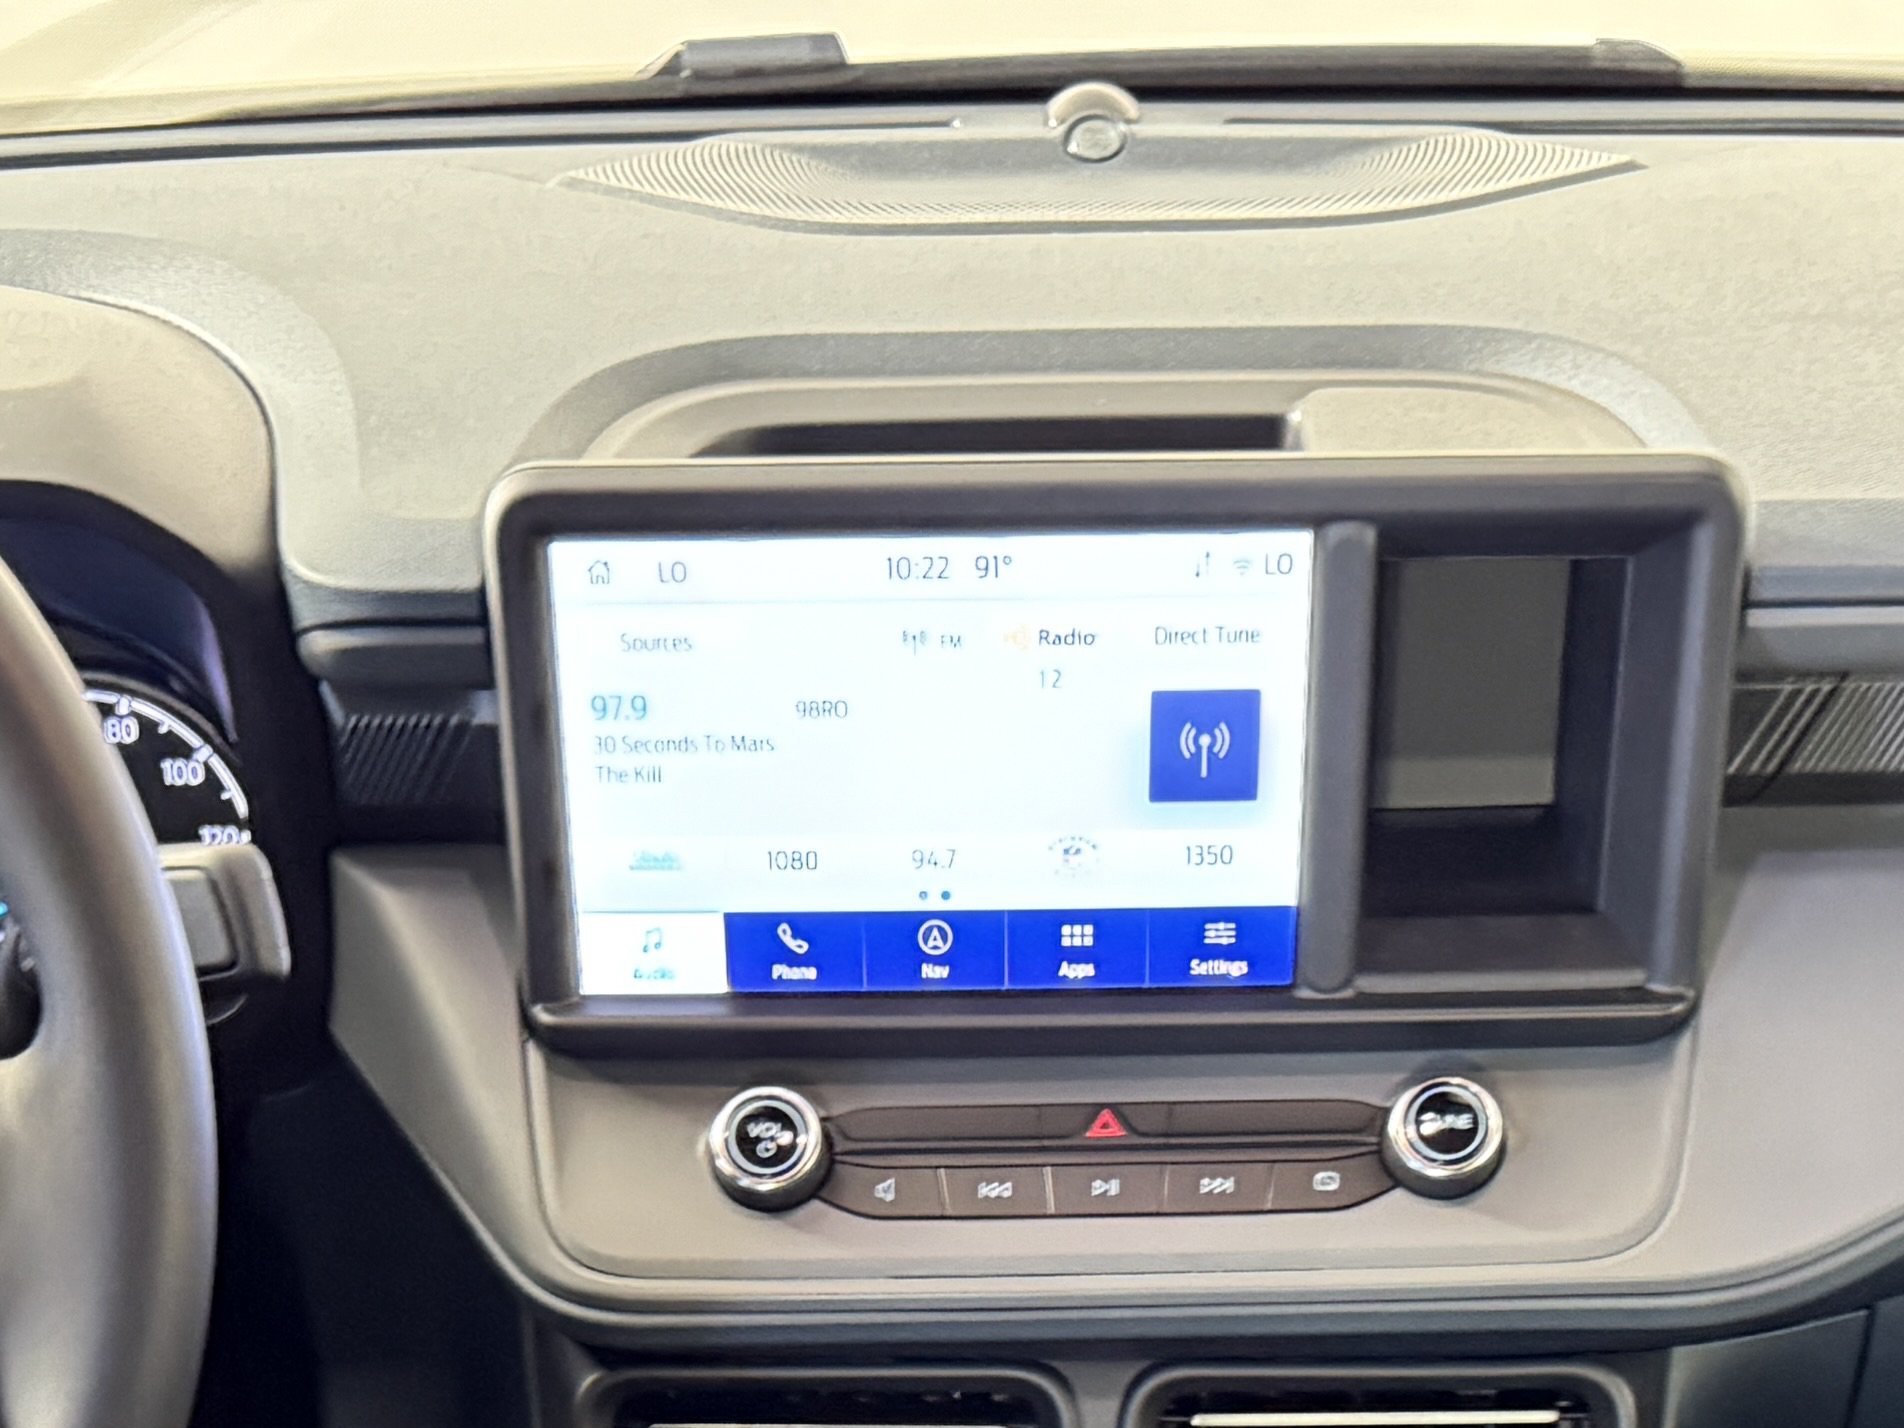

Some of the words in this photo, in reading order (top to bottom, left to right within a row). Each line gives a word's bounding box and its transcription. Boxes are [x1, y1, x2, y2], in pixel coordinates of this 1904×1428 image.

[887, 556, 950, 581] 10:22
[620, 633, 693, 652] Sources
[1038, 628, 1096, 647] Radio
[1155, 626, 1207, 646] Direct
[1215, 625, 1261, 645] Tune
[591, 695, 647, 721] 97.9
[104, 716, 140, 745] 80
[594, 735, 616, 754] 30
[622, 735, 698, 754] Seconds
[704, 735, 724, 753] To
[732, 735, 776, 752] Mars
[161, 758, 206, 786] 100
[596, 766, 629, 784] The
[634, 766, 662, 783] Kill
[768, 851, 818, 871] 1080
[912, 849, 956, 870] 94.7
[1186, 844, 1234, 866] 1350
[771, 963, 818, 982] Phone
[921, 963, 951, 980] Nav
[1058, 961, 1096, 980] Apps
[1190, 958, 1249, 980] Settings
